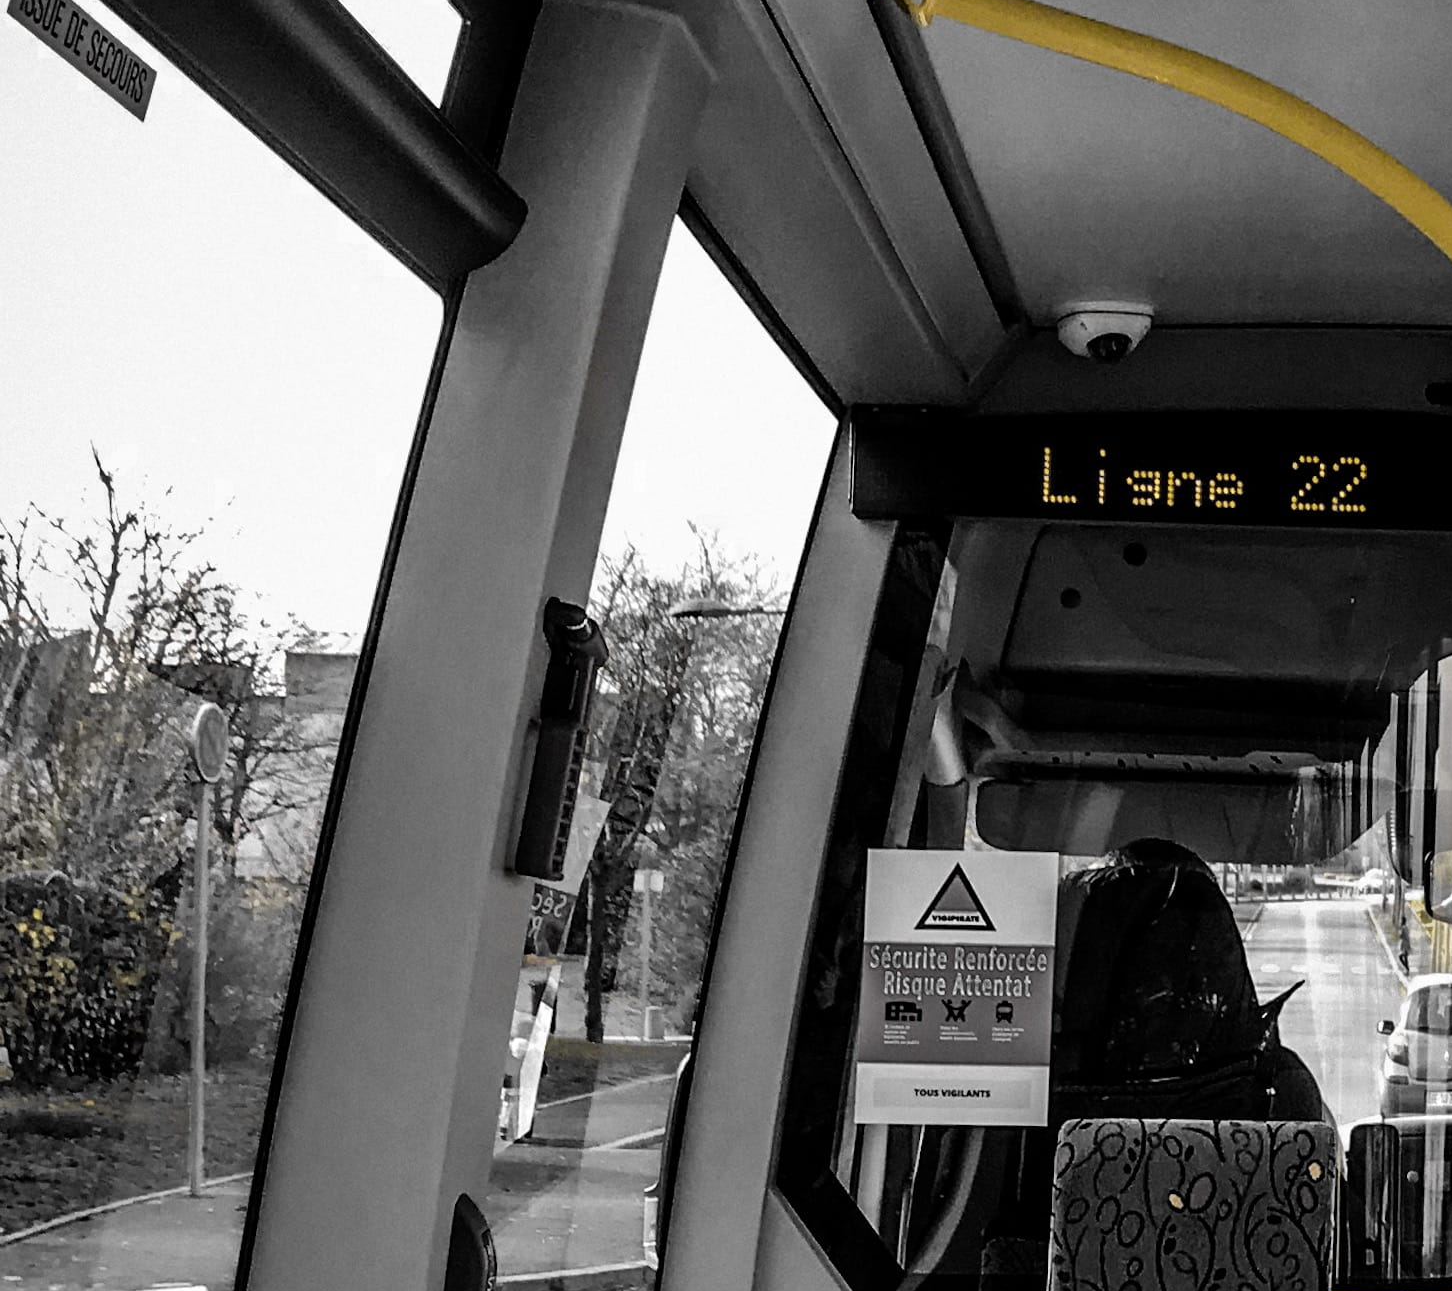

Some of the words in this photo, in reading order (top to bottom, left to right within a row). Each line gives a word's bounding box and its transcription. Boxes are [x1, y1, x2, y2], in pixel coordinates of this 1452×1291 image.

[64, 10, 89, 56] DE
[86, 29, 148, 104] SECOURS
[1043, 447, 1245, 508] Ligne
[1290, 455, 1368, 513] 22
[953, 947, 1048, 972] Renforcée
[883, 971, 946, 1001] Risque
[952, 973, 1032, 997] Attentat
[914, 1088, 939, 1097] TOUS
[941, 1088, 991, 1098] VIGILANTS
